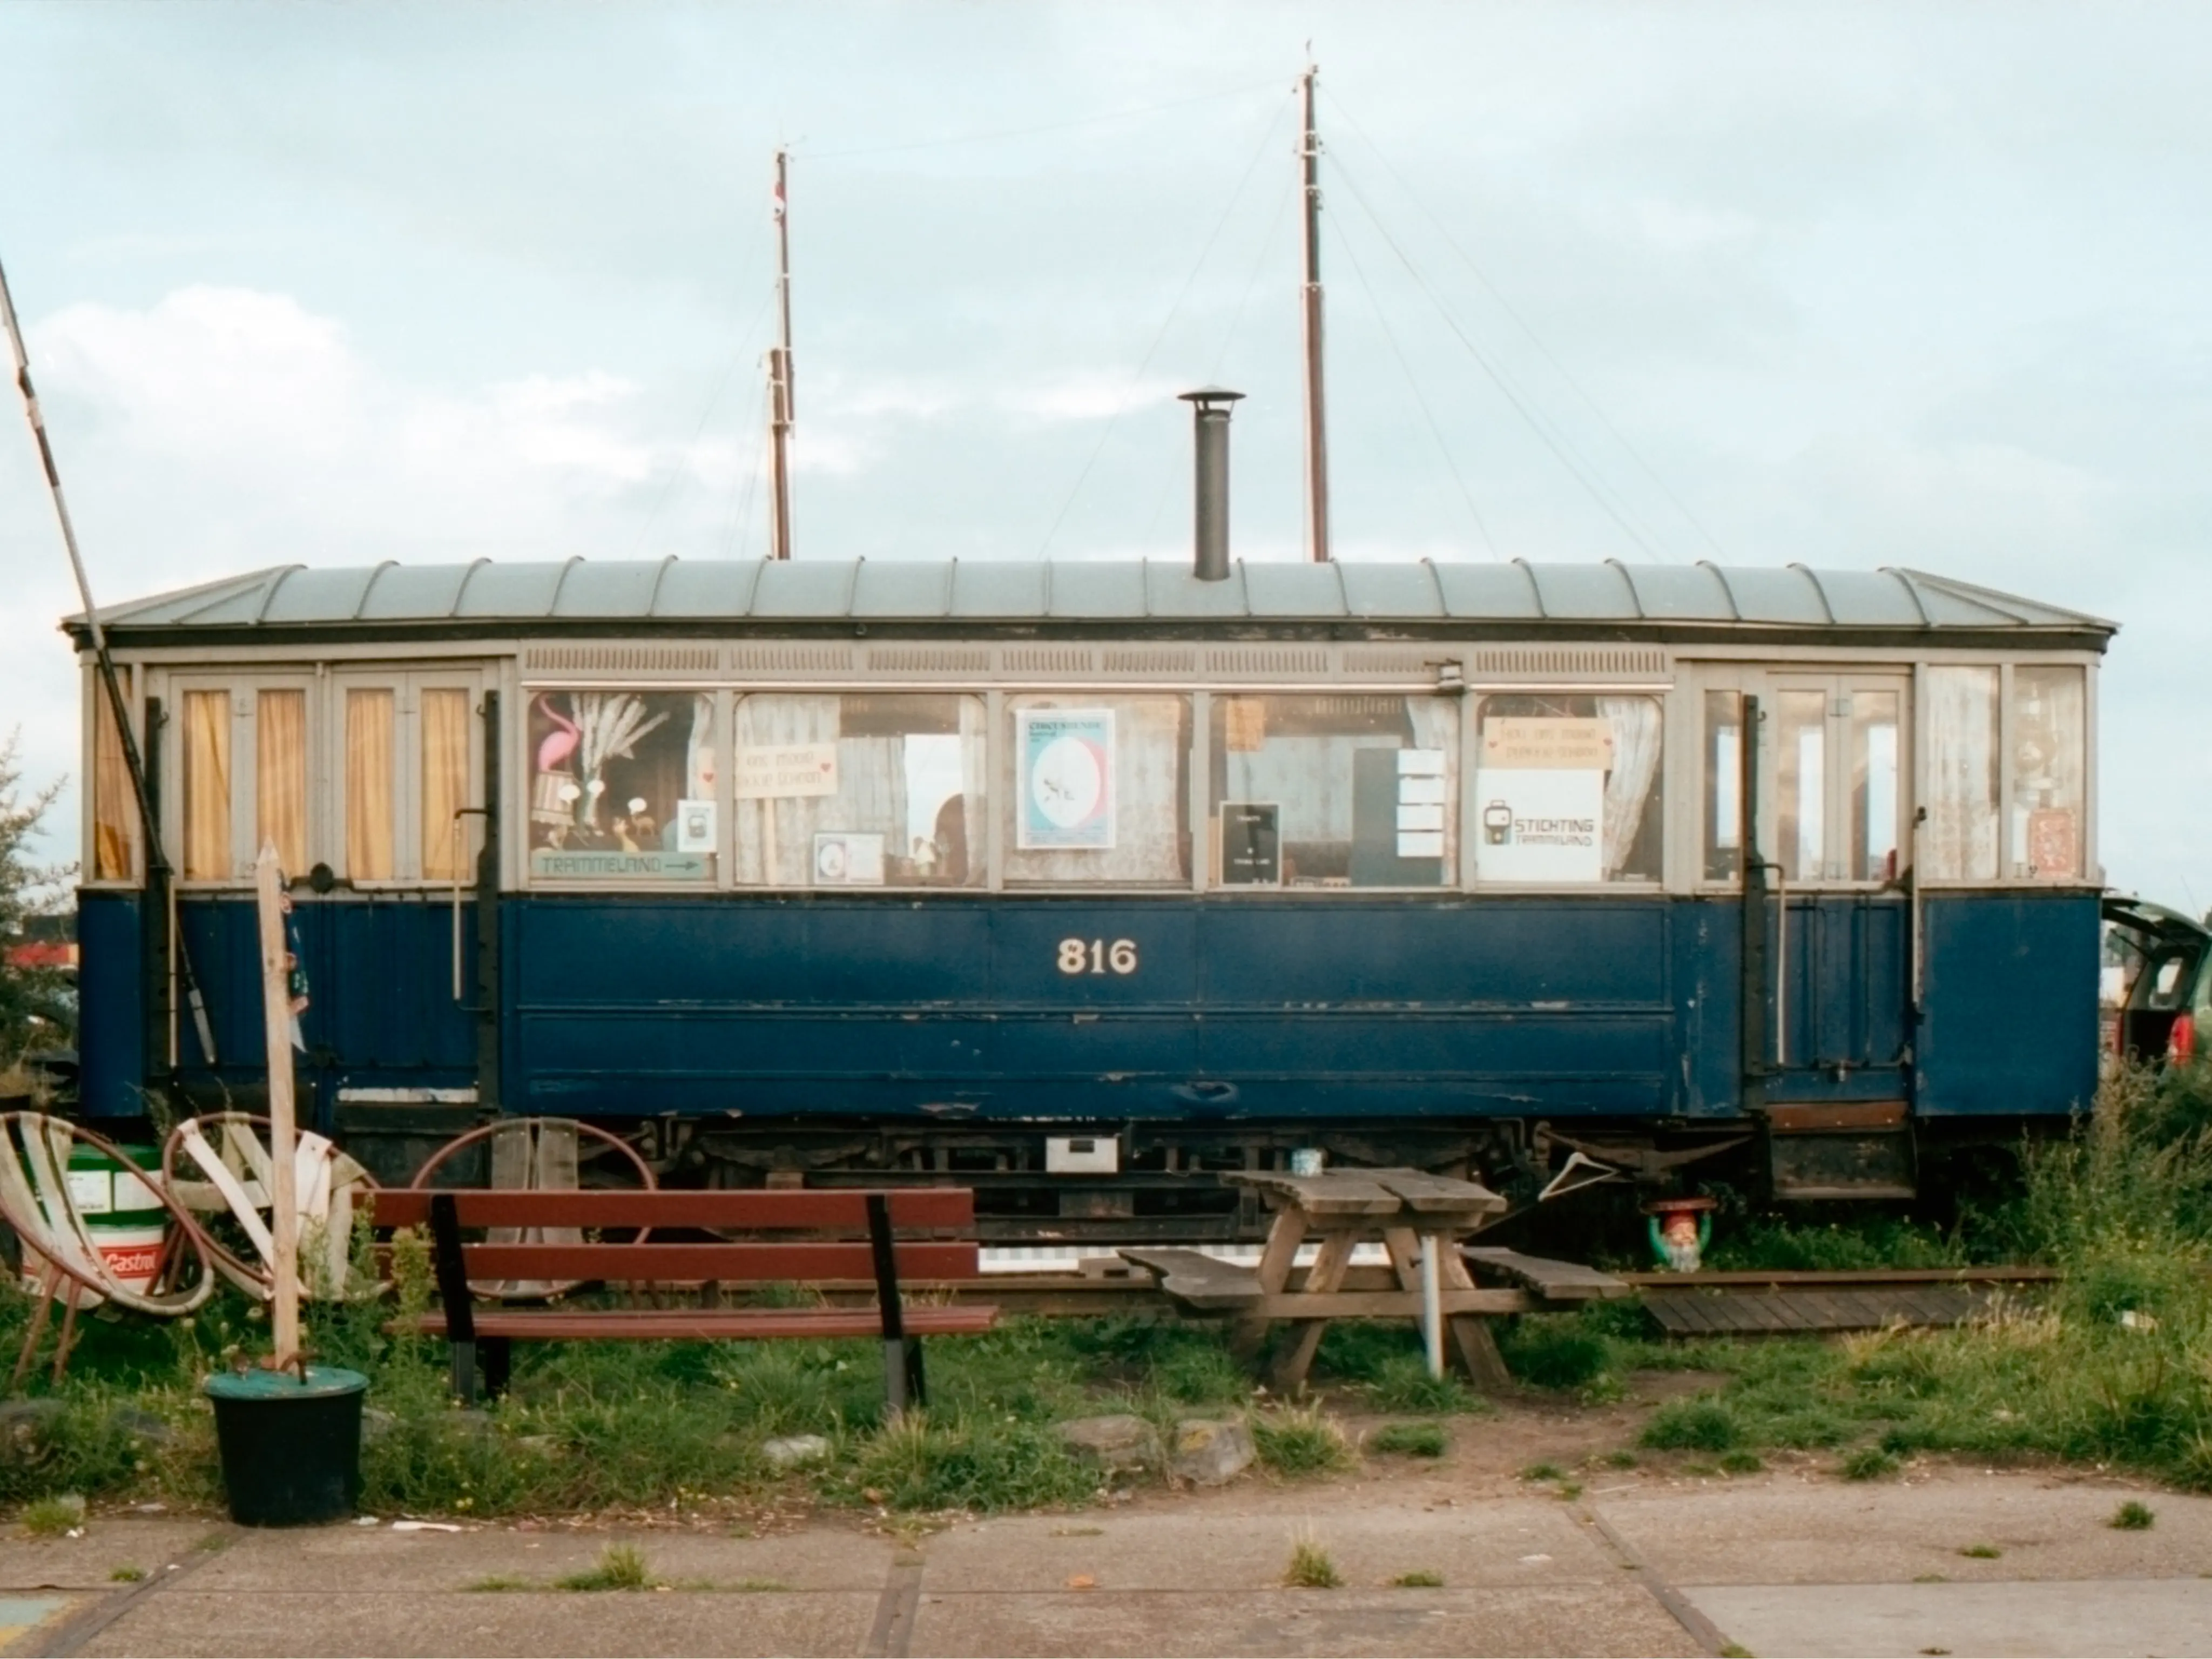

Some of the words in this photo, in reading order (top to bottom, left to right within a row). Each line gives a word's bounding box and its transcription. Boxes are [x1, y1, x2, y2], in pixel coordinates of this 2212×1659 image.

[1514, 819, 1594, 833] STICHTING
[1057, 939, 1137, 974] 816
[106, 1252, 157, 1271] Castrol
